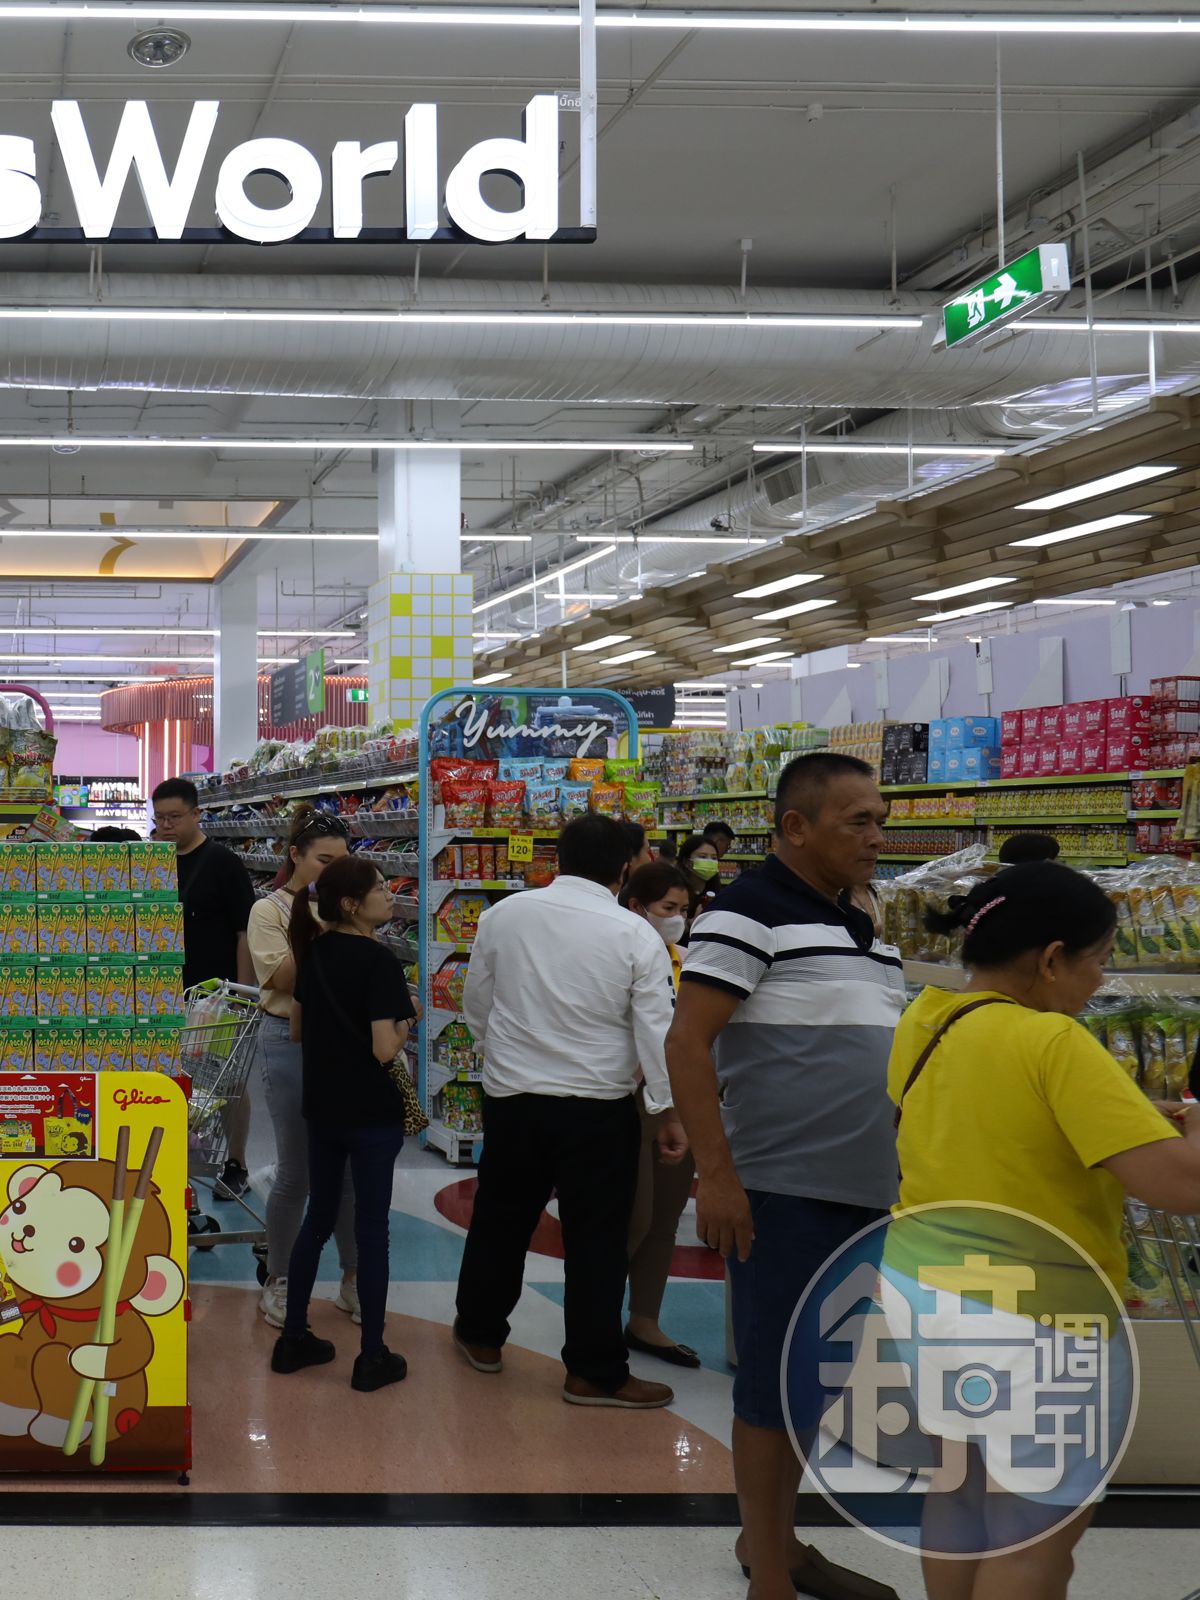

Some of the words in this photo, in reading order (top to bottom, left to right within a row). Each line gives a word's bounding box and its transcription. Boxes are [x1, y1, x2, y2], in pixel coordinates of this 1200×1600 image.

[455, 700, 607, 758] Yummy
[95, 809, 147, 817] MAYBELLIN
[510, 845, 528, 855] 120
[112, 1089, 171, 1111] Glico
